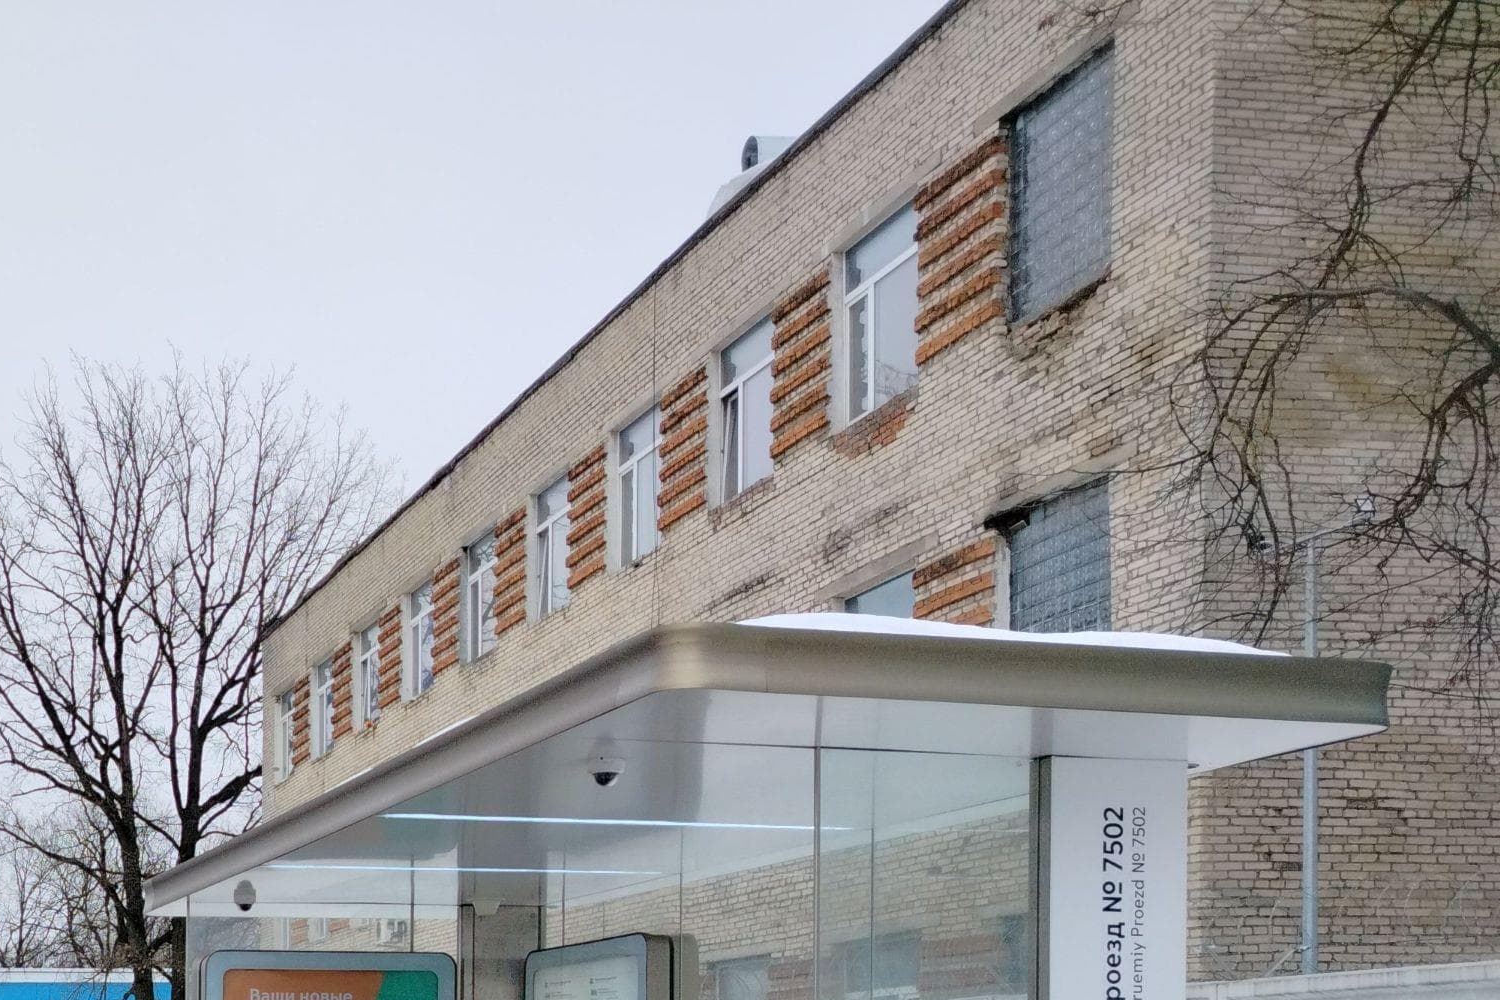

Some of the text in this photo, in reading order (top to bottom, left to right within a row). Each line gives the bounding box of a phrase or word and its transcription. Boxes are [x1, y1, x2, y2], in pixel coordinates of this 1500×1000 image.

[1102, 807, 1124, 872] 7502
[1132, 807, 1146, 848] 7502
[1131, 853, 1146, 873] №
[1102, 881, 1123, 913] №
[1131, 879, 1145, 937] Proezd
